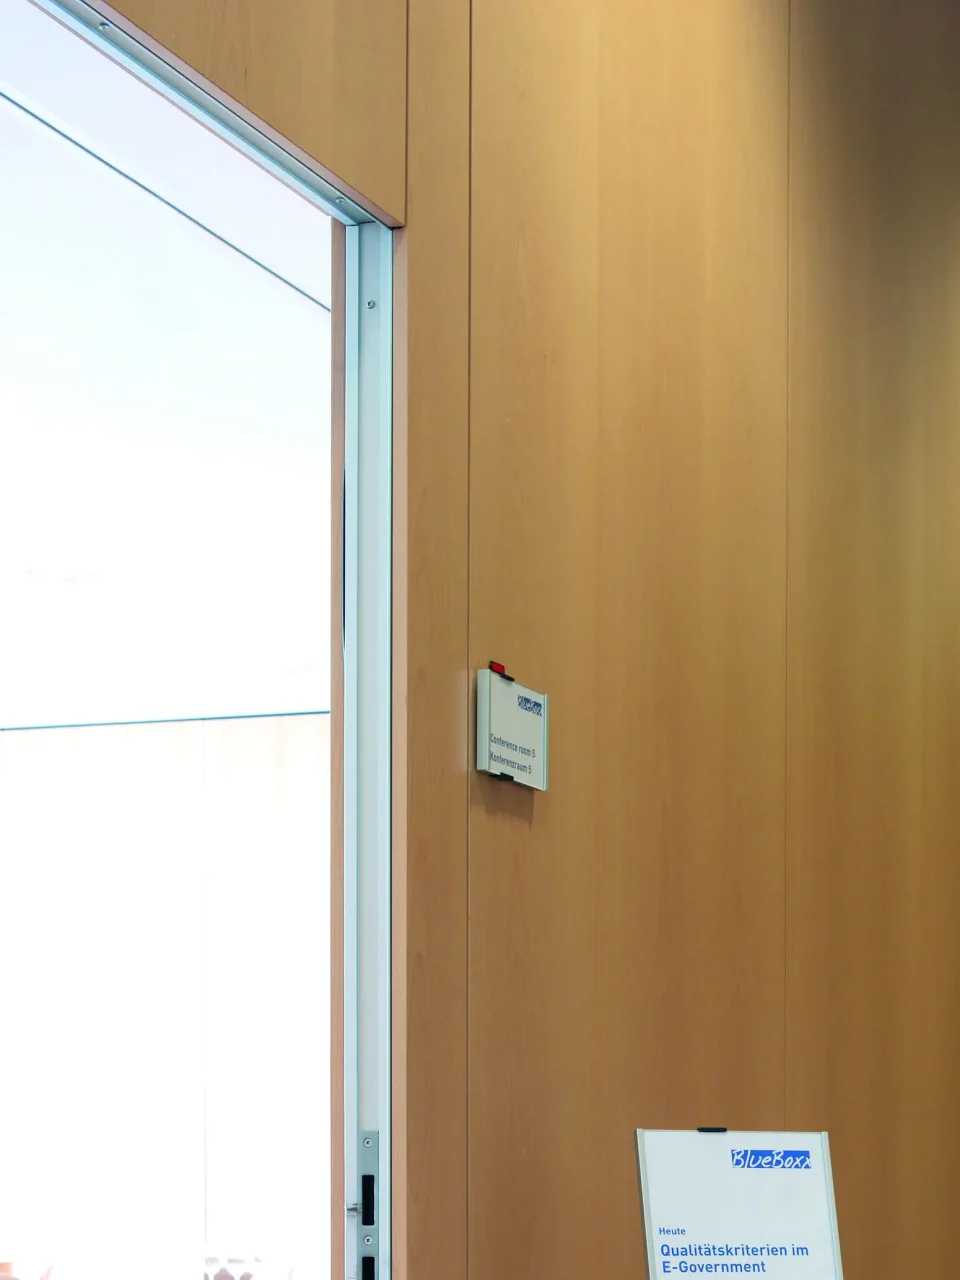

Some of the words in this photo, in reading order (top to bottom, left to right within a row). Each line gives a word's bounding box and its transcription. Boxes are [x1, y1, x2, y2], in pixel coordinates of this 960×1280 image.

[490, 733, 518, 752] Conference
[519, 746, 531, 756] room
[532, 749, 535, 758] 5
[490, 751, 527, 773] Konferenzraum
[528, 765, 531, 774] 5
[731, 1150, 811, 1169] BlueBoxx
[659, 1227, 686, 1236] Heute
[661, 1244, 788, 1257] Qualitätskriterien
[792, 1244, 809, 1256] im
[662, 1261, 766, 1274] E-Government
